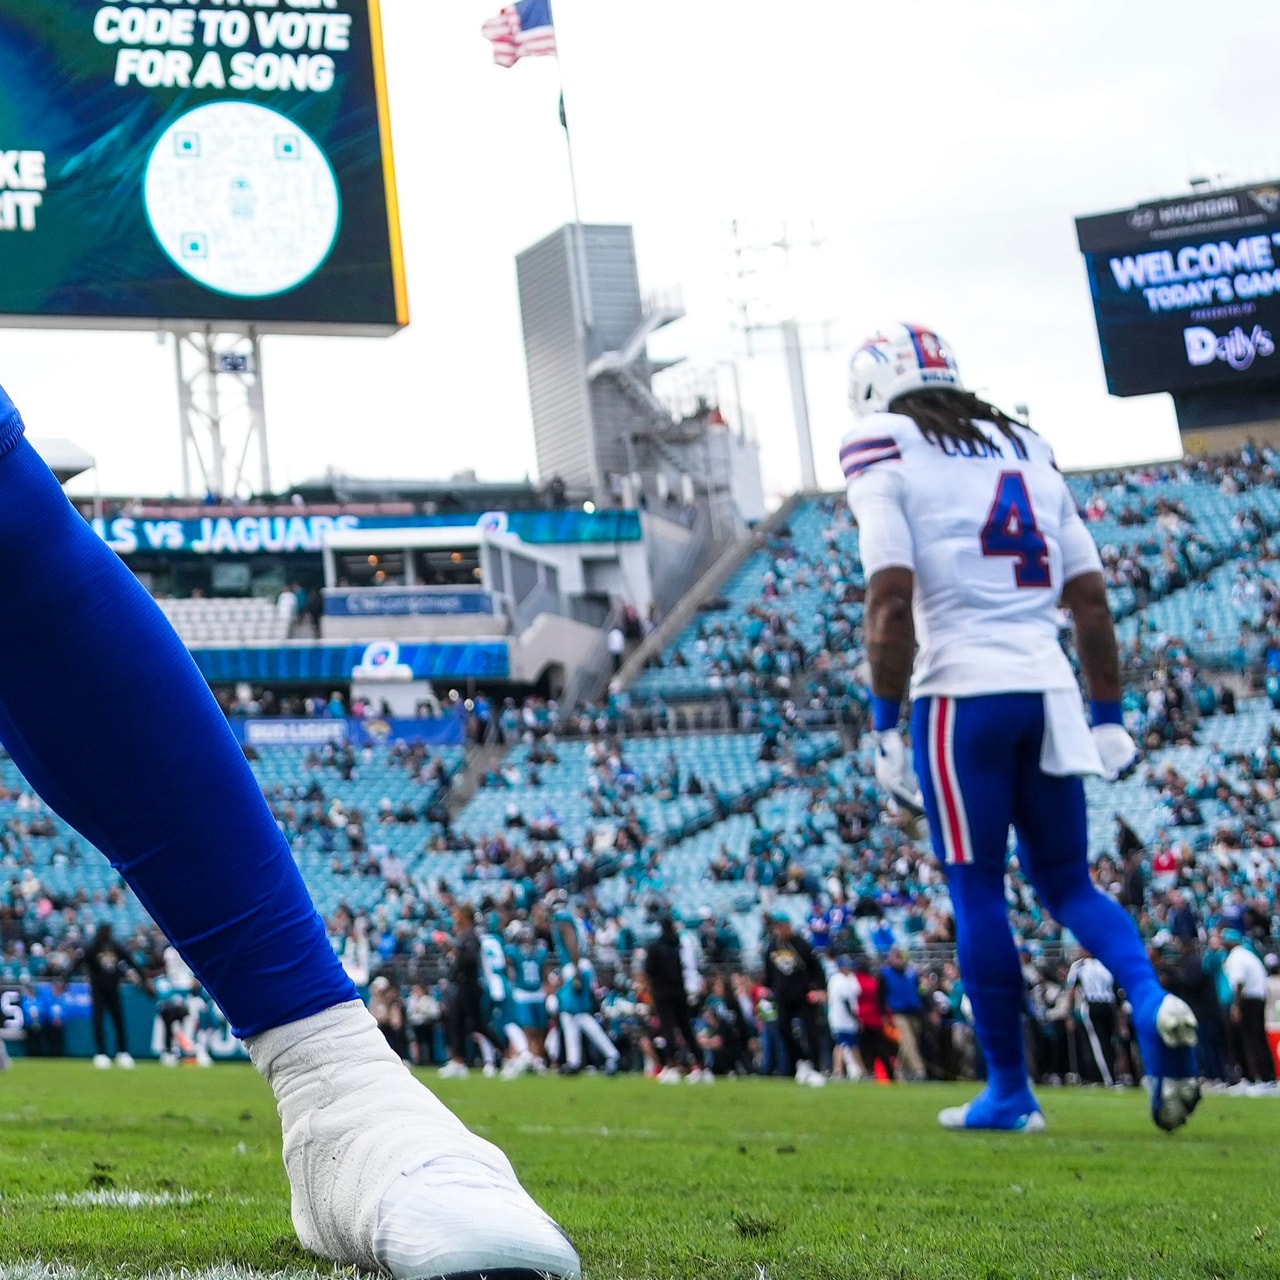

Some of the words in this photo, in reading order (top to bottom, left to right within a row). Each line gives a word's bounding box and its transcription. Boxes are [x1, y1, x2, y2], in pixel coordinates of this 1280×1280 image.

[93, 5, 197, 46] CODE
[198, 9, 251, 48] TO
[253, 11, 353, 51] VOTE
[114, 48, 193, 88] FOR
[192, 51, 227, 90] A
[228, 51, 336, 93] SONG
[1109, 234, 1275, 292] WELCOME
[1143, 276, 1235, 313] TODAY'S
[981, 471, 1052, 588] 4
